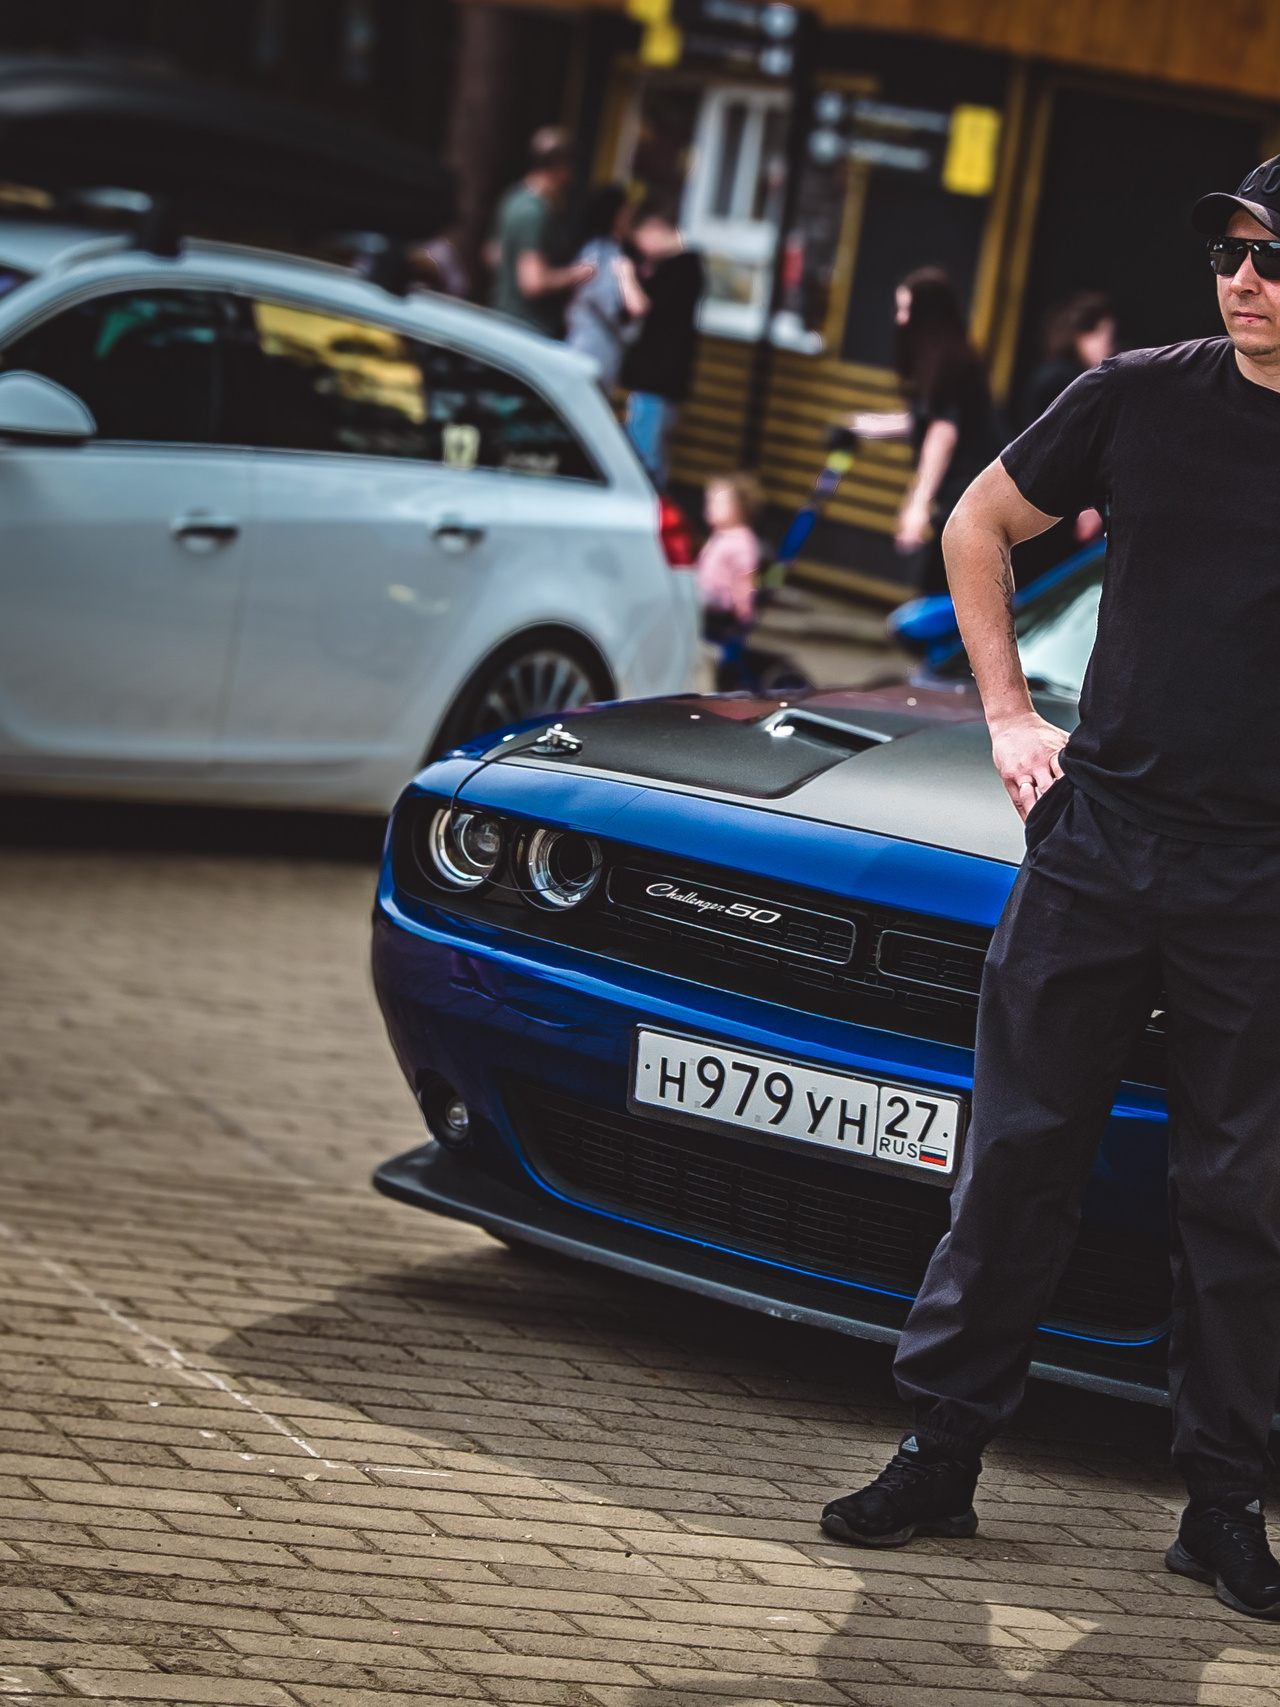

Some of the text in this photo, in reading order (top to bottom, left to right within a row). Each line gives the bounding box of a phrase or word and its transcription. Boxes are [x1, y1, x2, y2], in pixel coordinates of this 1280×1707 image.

[646, 883, 782, 924] Challenger 50
[884, 1096, 939, 1143] 27
[879, 1137, 918, 1159] RUS
